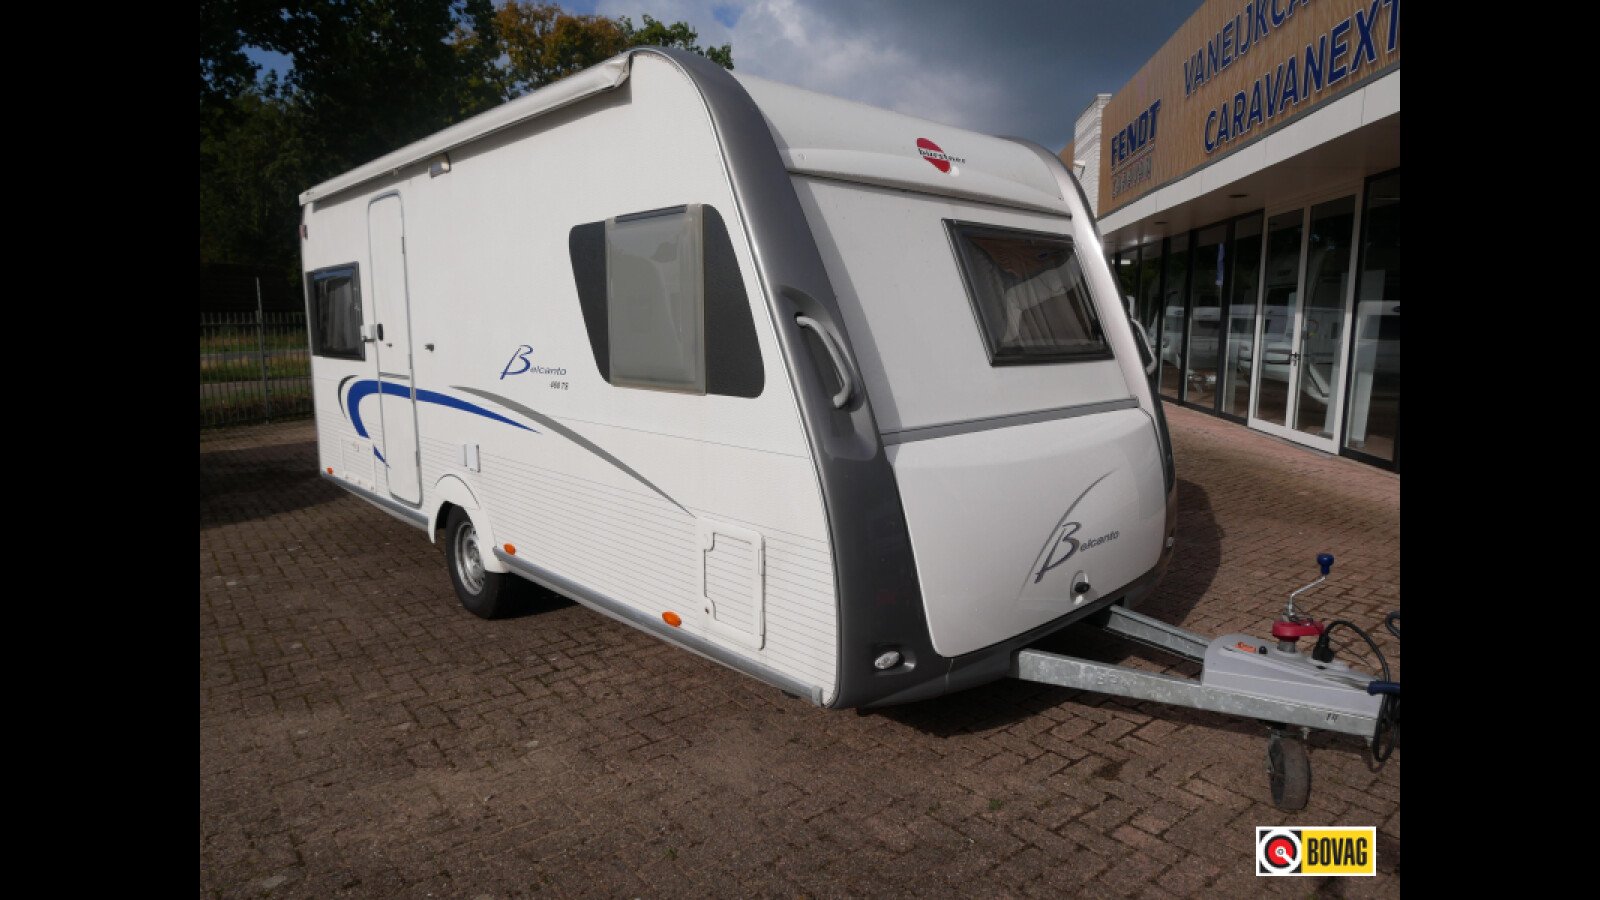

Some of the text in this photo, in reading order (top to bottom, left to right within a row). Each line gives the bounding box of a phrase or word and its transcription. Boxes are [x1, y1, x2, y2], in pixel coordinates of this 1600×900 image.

[1111, 99, 1161, 167] FENDT
[499, 344, 567, 380] Belcanto
[1034, 521, 1120, 584] Belcanto
